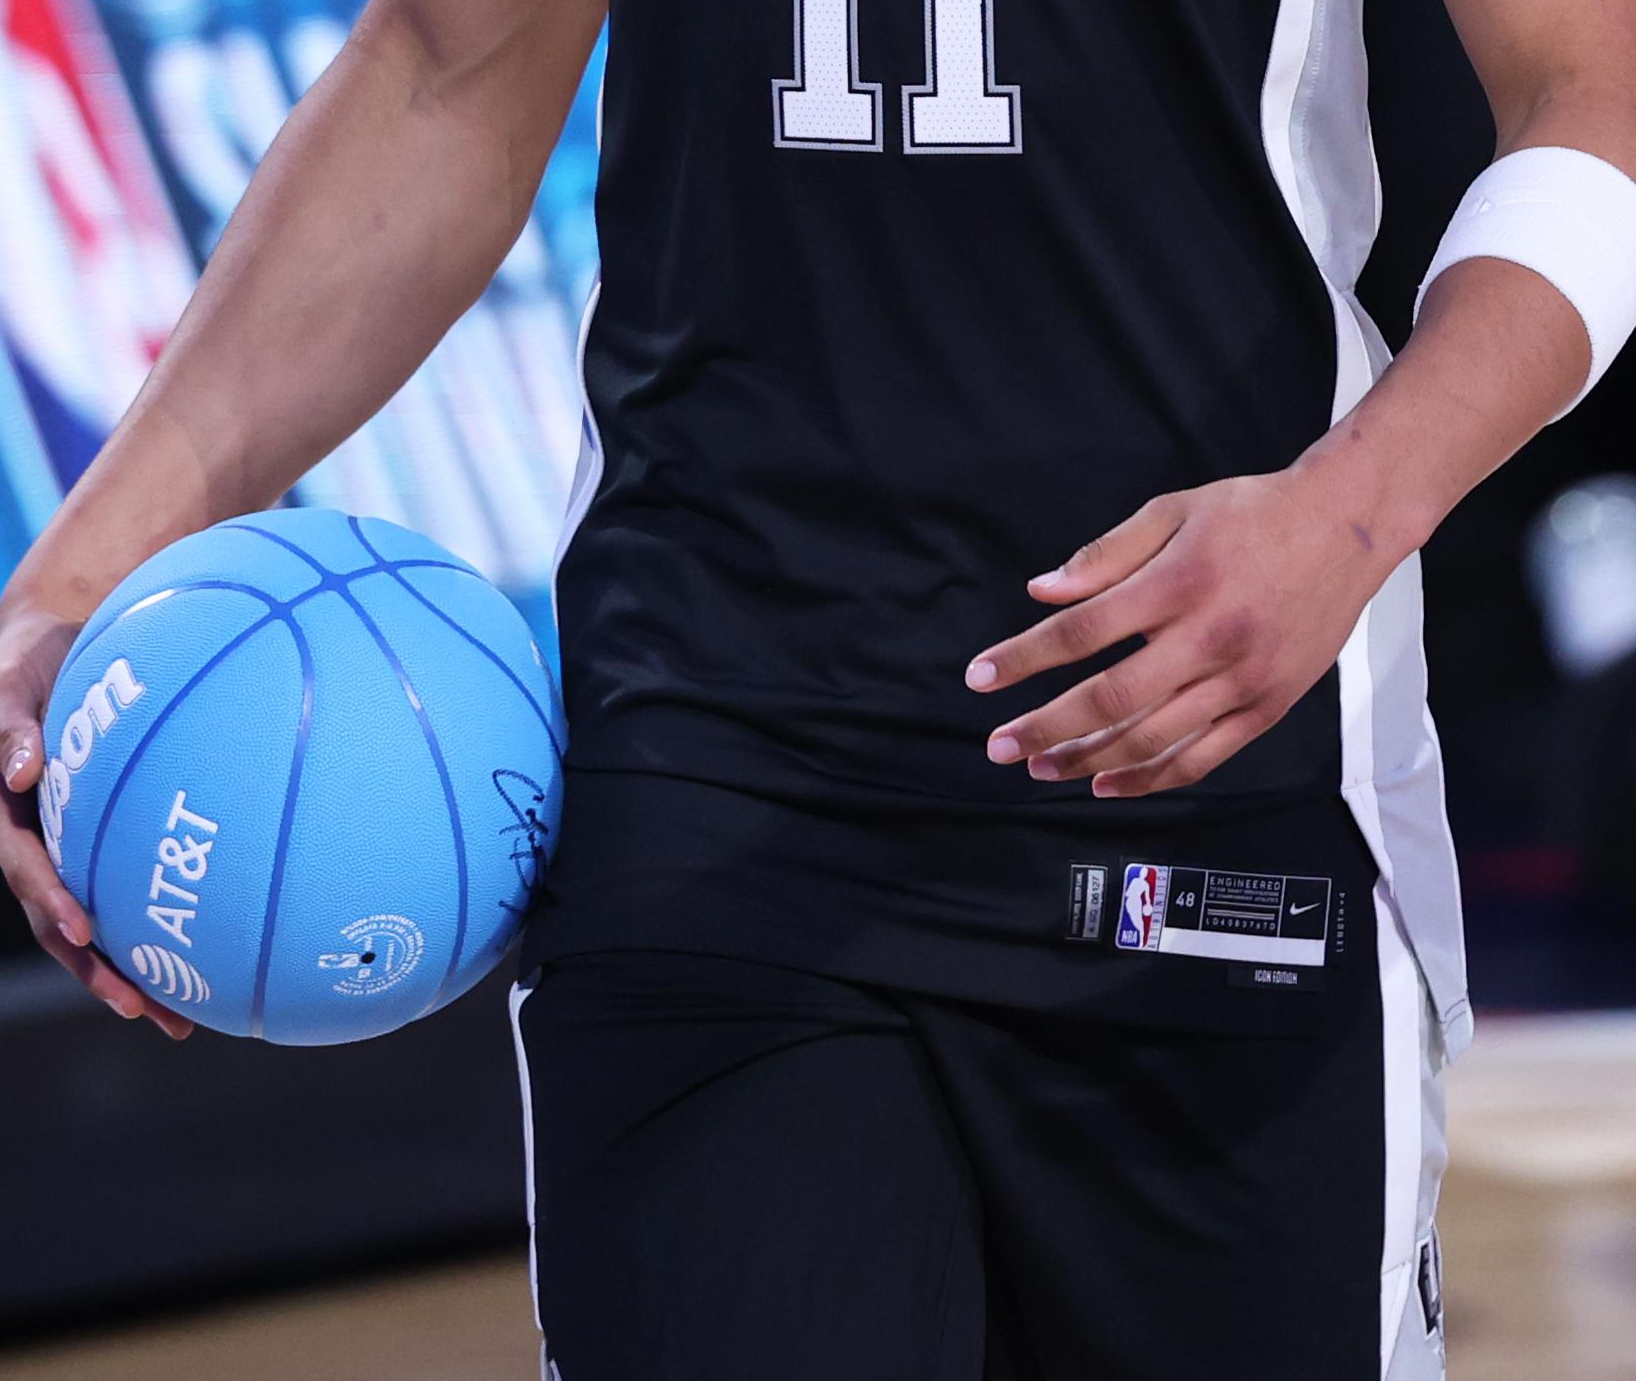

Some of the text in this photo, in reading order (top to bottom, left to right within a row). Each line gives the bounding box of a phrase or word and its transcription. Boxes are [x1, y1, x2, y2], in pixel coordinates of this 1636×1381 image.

[146, 789, 219, 949] AT&T
[1209, 876, 1281, 891] ENGINEERED
[1175, 891, 1195, 908] 48
